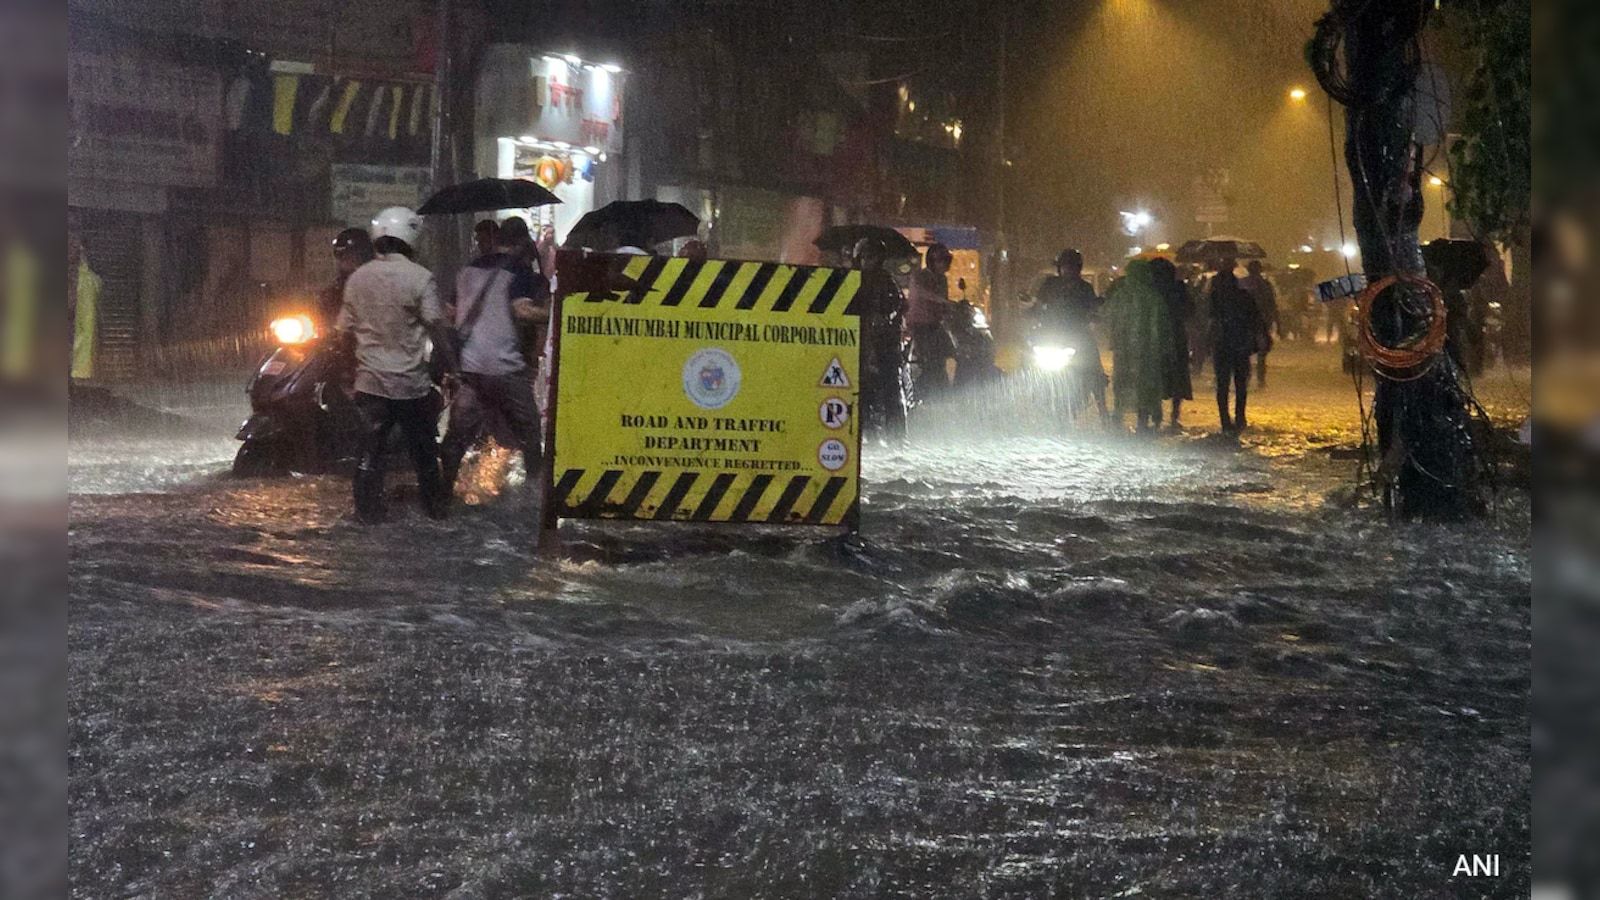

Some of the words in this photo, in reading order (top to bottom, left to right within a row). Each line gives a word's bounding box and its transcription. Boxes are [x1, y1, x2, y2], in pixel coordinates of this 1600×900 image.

[567, 315, 680, 338] BRIHANMUMBAI
[684, 320, 760, 342] MUNICIPAL
[763, 324, 858, 346] CORPORATION
[621, 414, 669, 429] ROAD
[674, 416, 709, 430] AND
[713, 417, 786, 433] TRAFFIC
[644, 436, 761, 452] DEPARTMENT
[827, 443, 840, 451] GO
